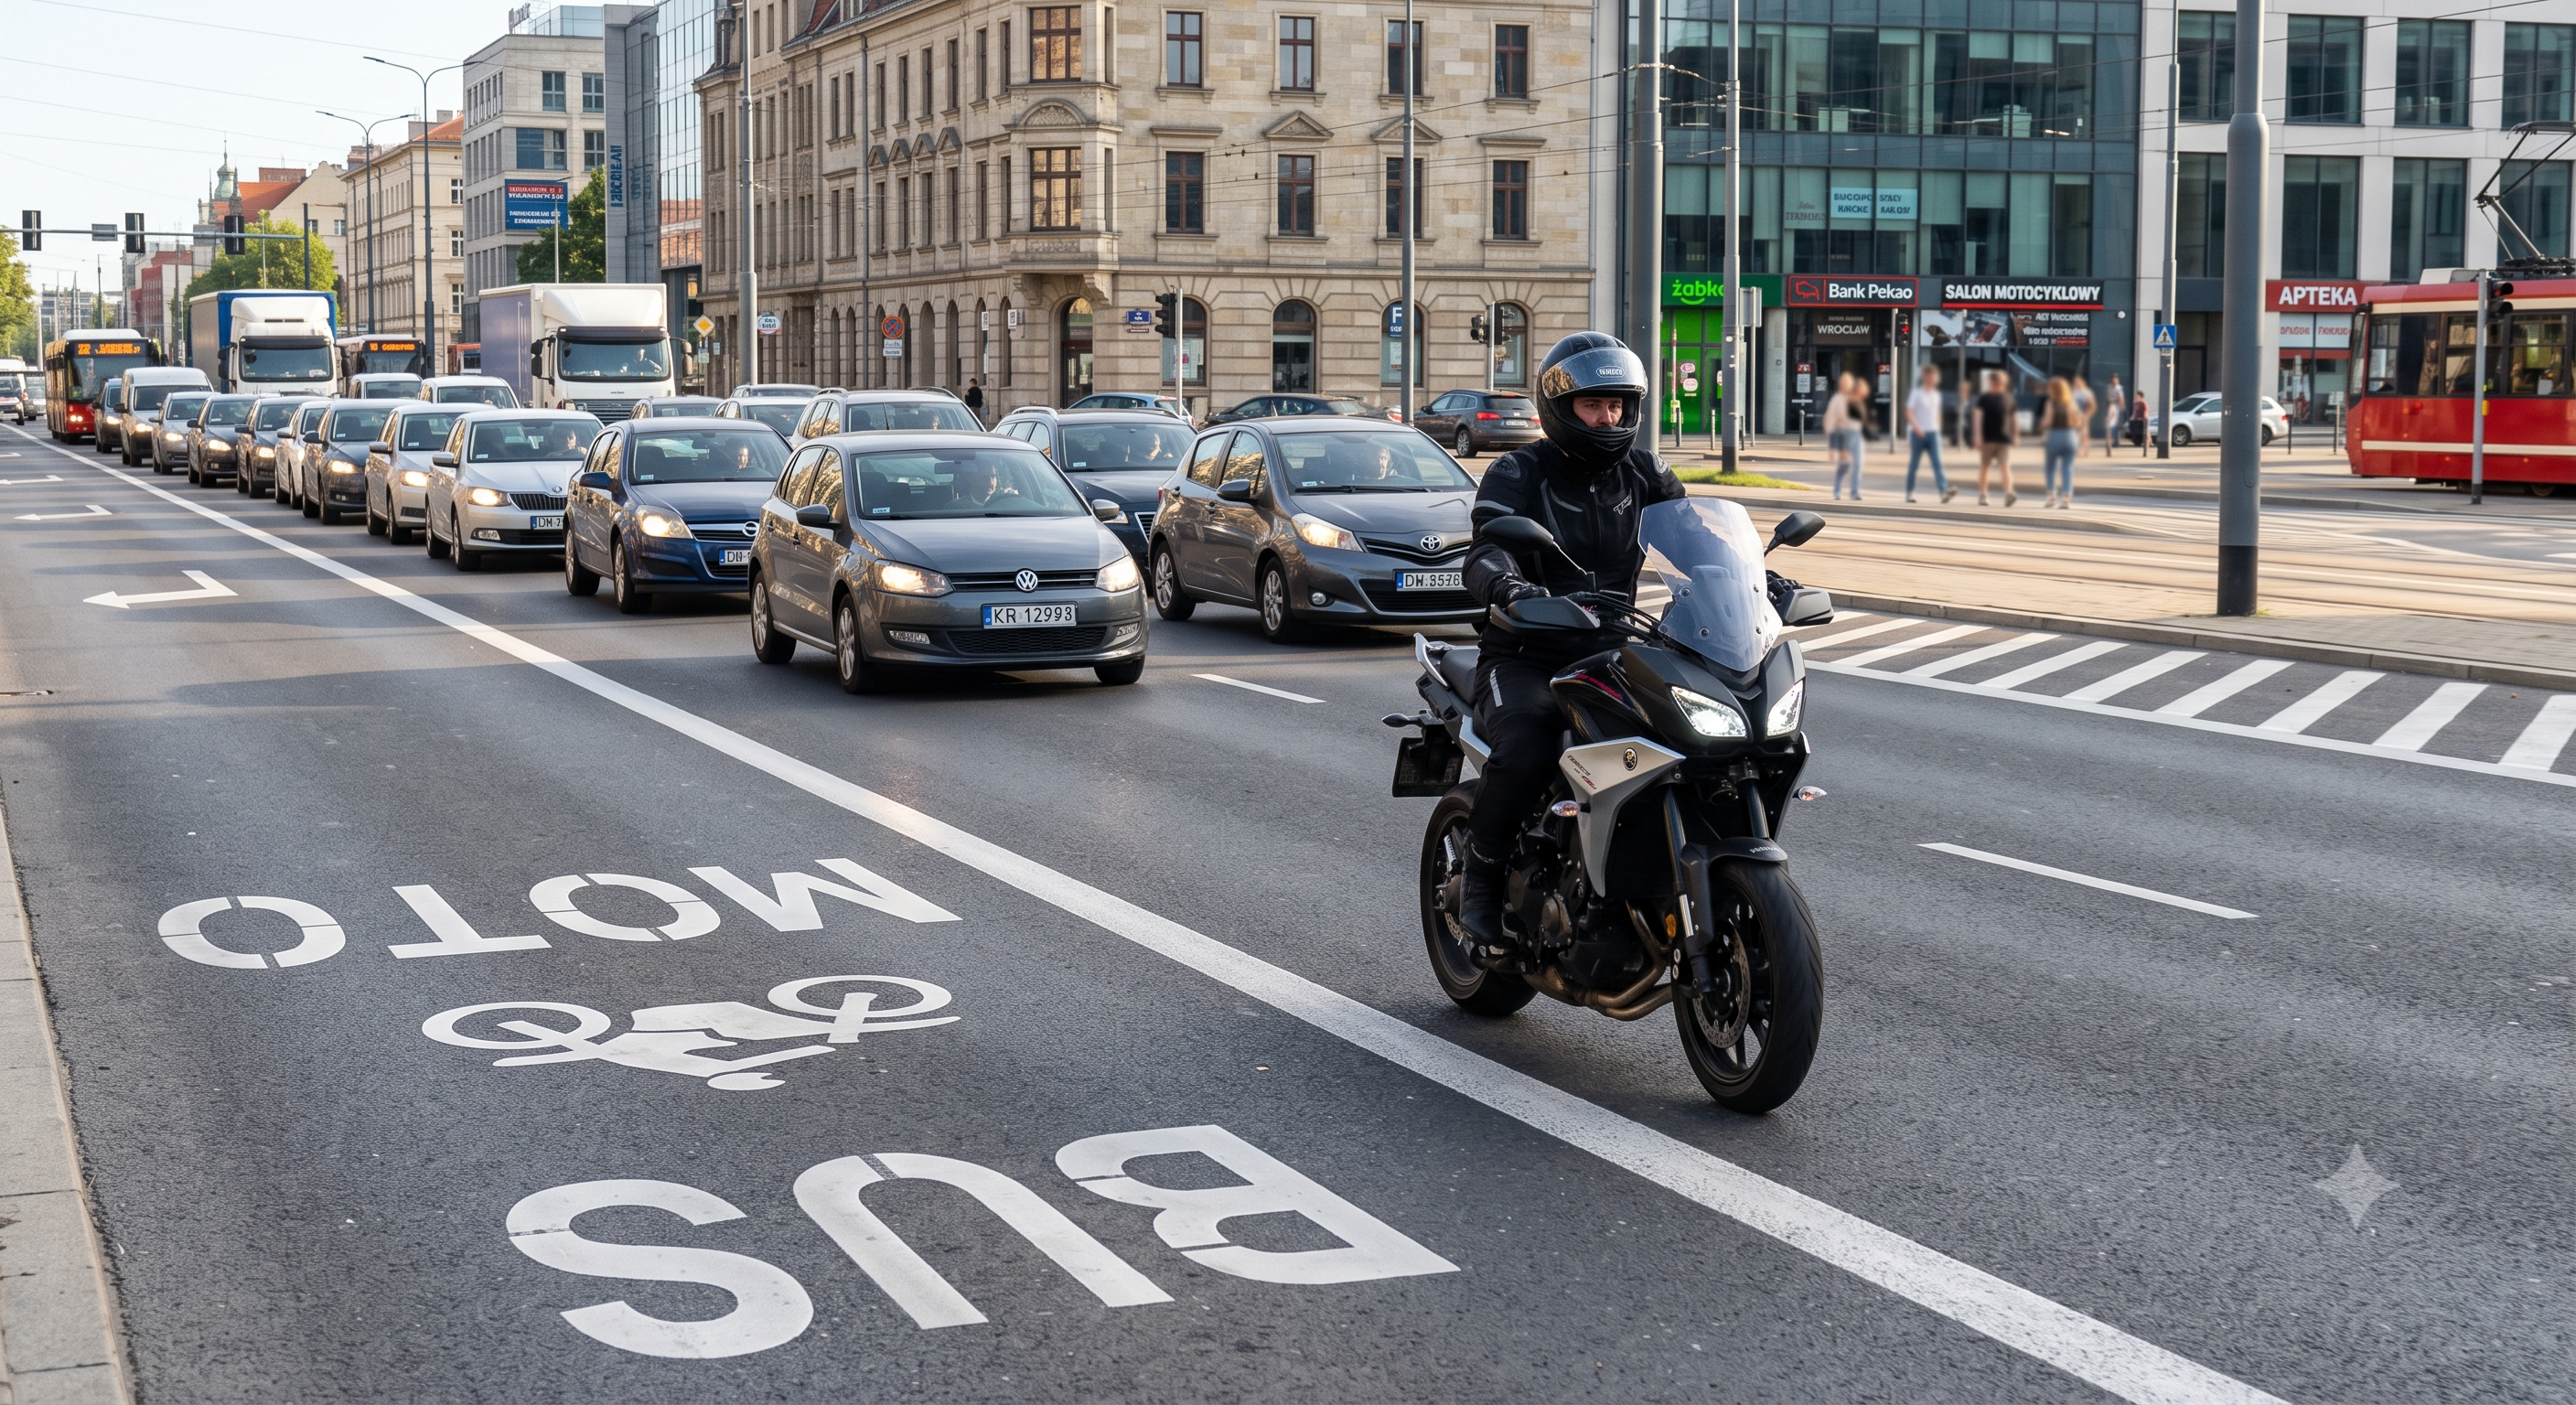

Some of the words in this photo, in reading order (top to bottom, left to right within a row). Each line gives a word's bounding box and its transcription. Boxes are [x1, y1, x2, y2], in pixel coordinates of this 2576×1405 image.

[1829, 284, 1865, 299] Bank
[1868, 284, 1913, 300] Pekao
[1945, 284, 1991, 300] SALON
[1995, 284, 2100, 301] MOTOCYKLOWY
[2278, 285, 2358, 306] APTEKA
[1817, 325, 1871, 335] WROCLAW
[993, 607, 1016, 624] KR
[1025, 606, 1073, 623] 12993
[157, 857, 962, 970] MOTO
[505, 1123, 1462, 1360] BUS
